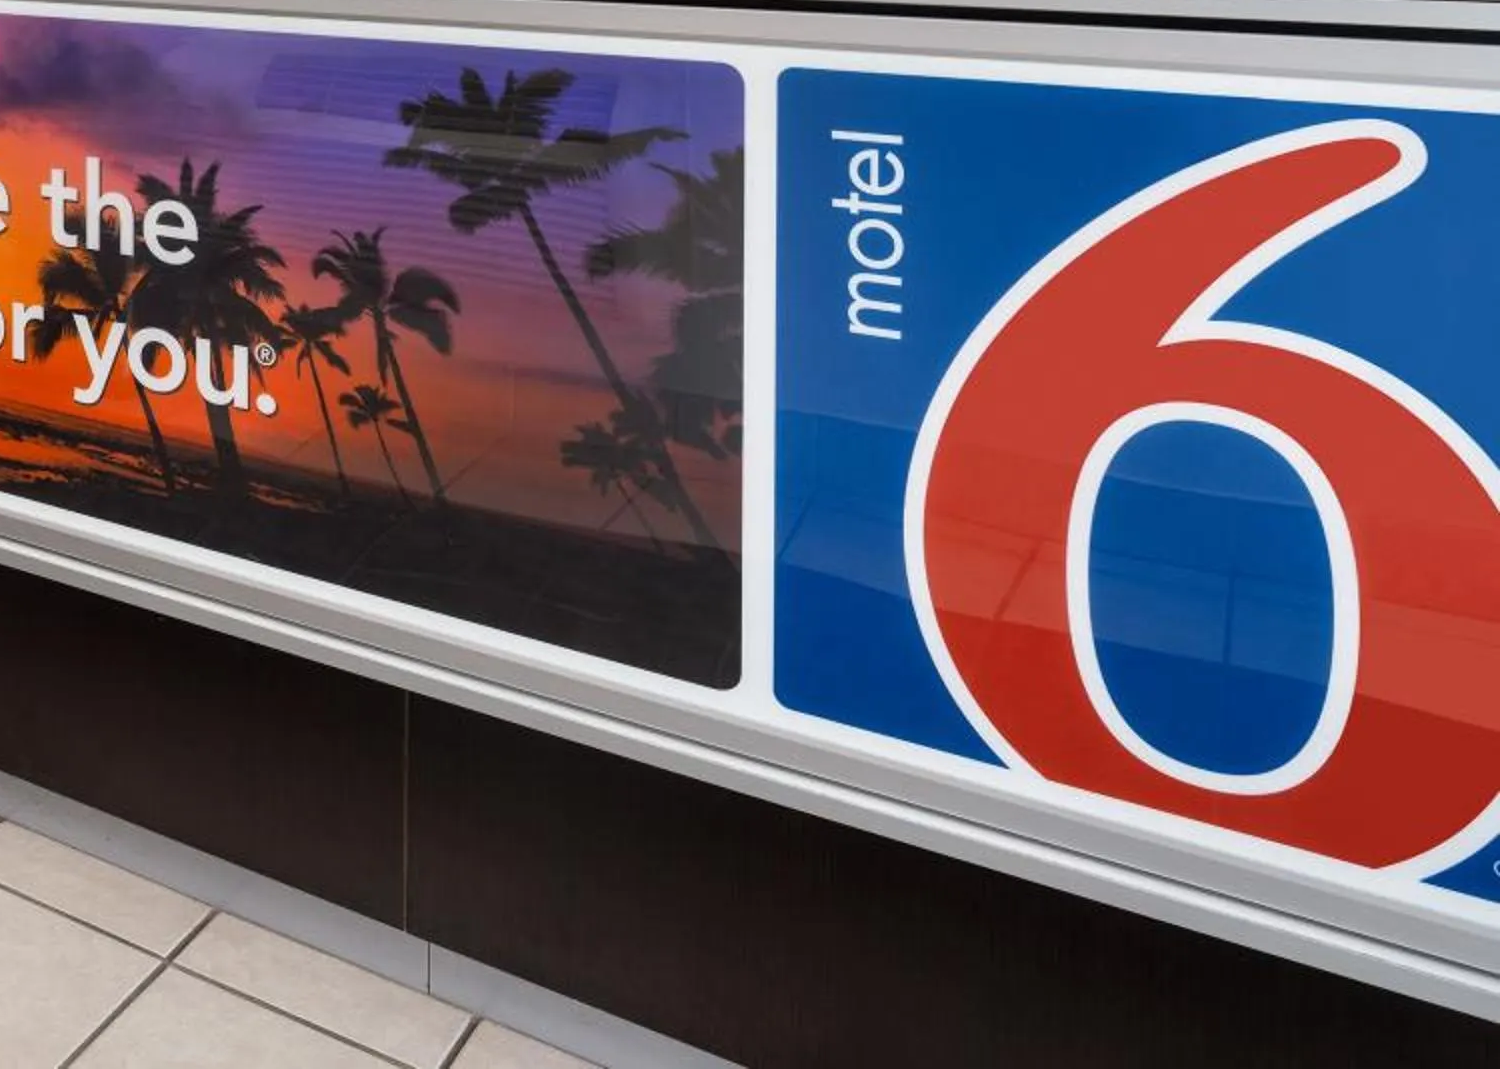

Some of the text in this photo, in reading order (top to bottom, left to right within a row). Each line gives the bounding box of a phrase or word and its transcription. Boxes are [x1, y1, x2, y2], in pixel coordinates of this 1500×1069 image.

[41, 157, 199, 266] the
[831, 130, 905, 340] motel
[903, 117, 1500, 881] 6
